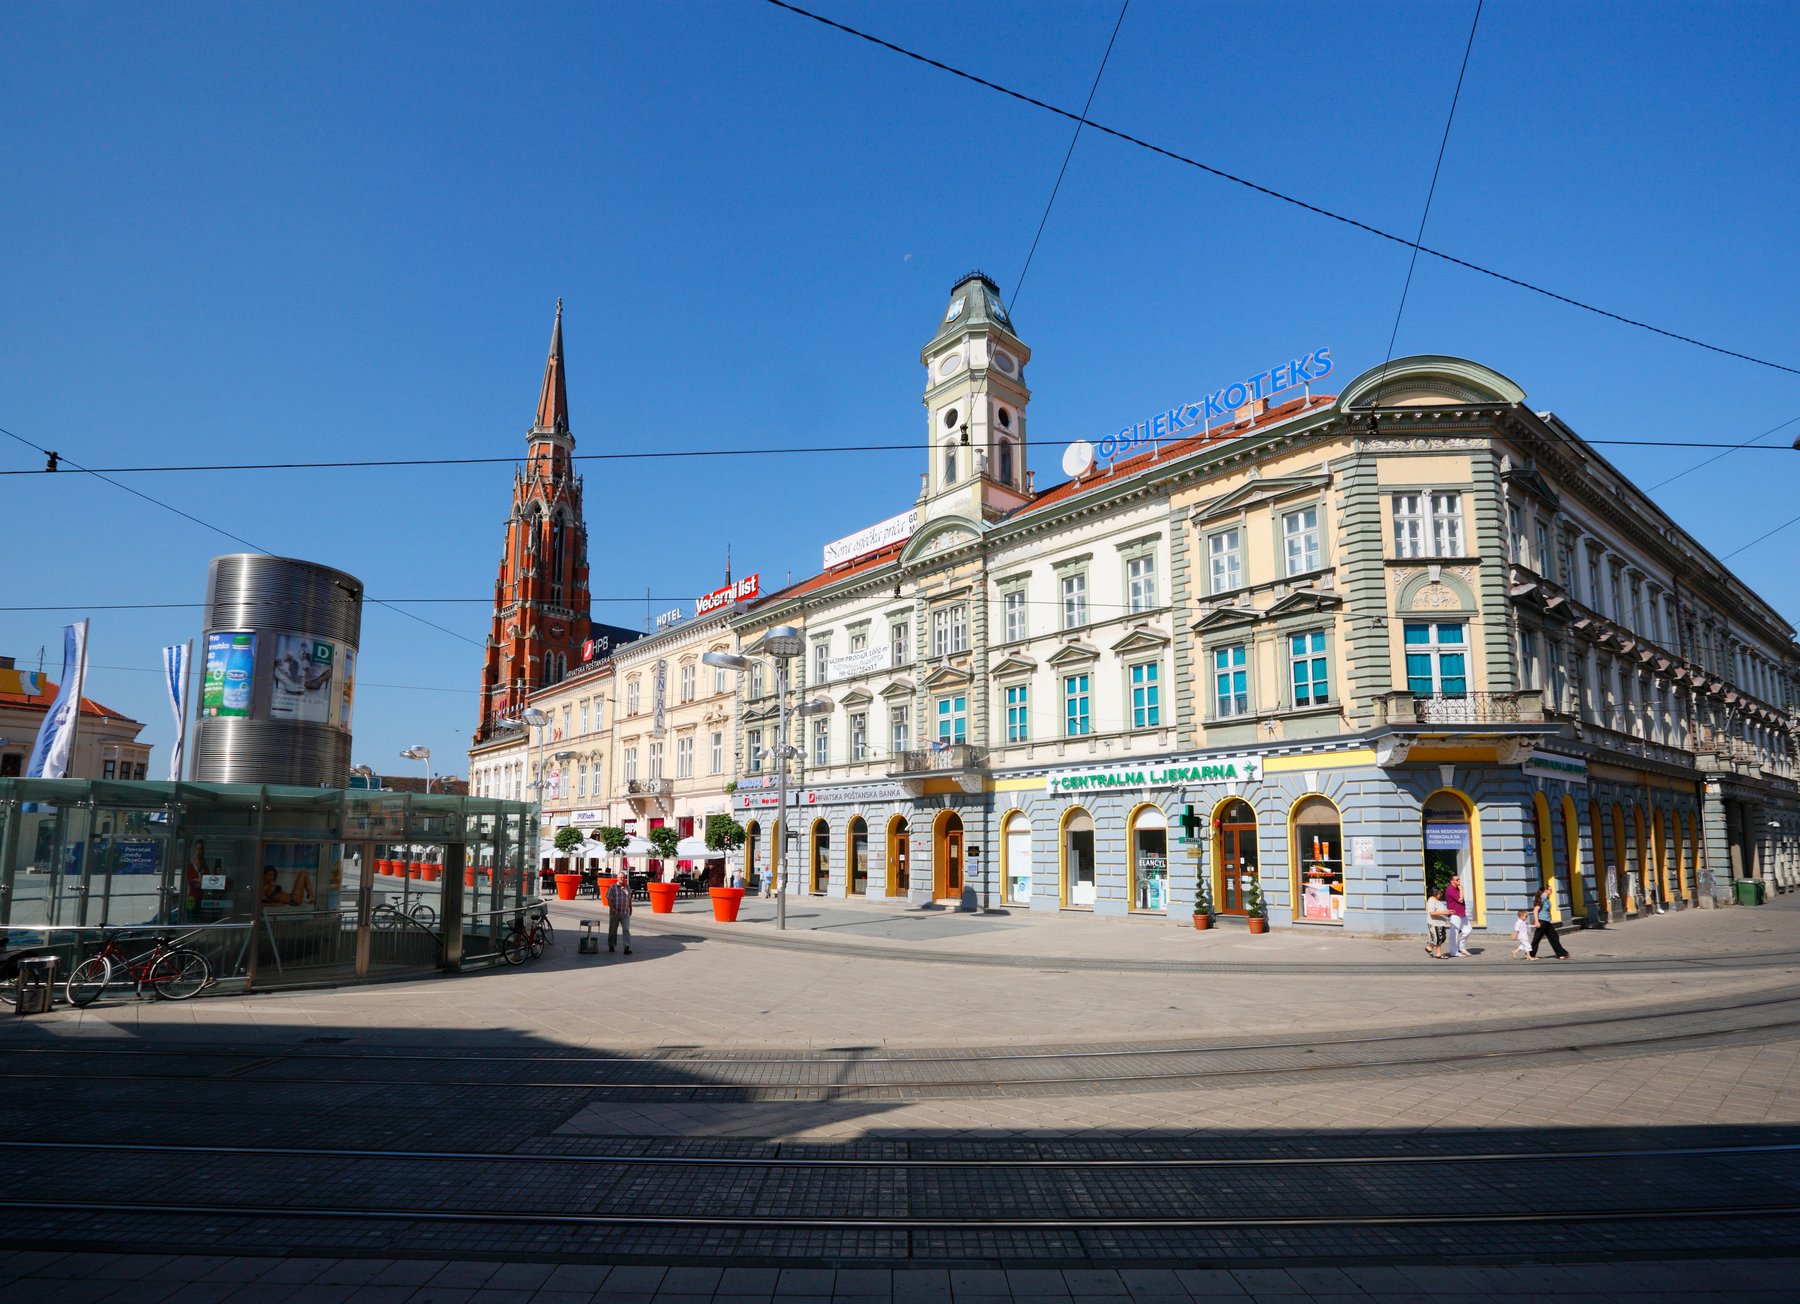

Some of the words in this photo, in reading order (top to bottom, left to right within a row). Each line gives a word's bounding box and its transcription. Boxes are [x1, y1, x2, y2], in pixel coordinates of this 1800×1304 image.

[1099, 403, 1189, 459] OSIJEK
[1203, 346, 1334, 420] KOTEKS
[696, 584, 738, 615] Večernji
[738, 576, 757, 597] list
[656, 608, 682, 627] HOTEL
[317, 646, 329, 659] D
[592, 635, 609, 655] HPB
[565, 666, 586, 678] HRVATSKA
[586, 656, 610, 672] POŠTANSKA
[657, 660, 666, 728] CENTRAL
[1061, 771, 1145, 789] CENTRALNA
[1150, 764, 1237, 783] LJEKARNA
[816, 793, 843, 801] HRVATSKA
[844, 790, 878, 800] POŠTANSKA
[879, 789, 900, 797] BANKA
[1139, 859, 1166, 868] ELANCYL
